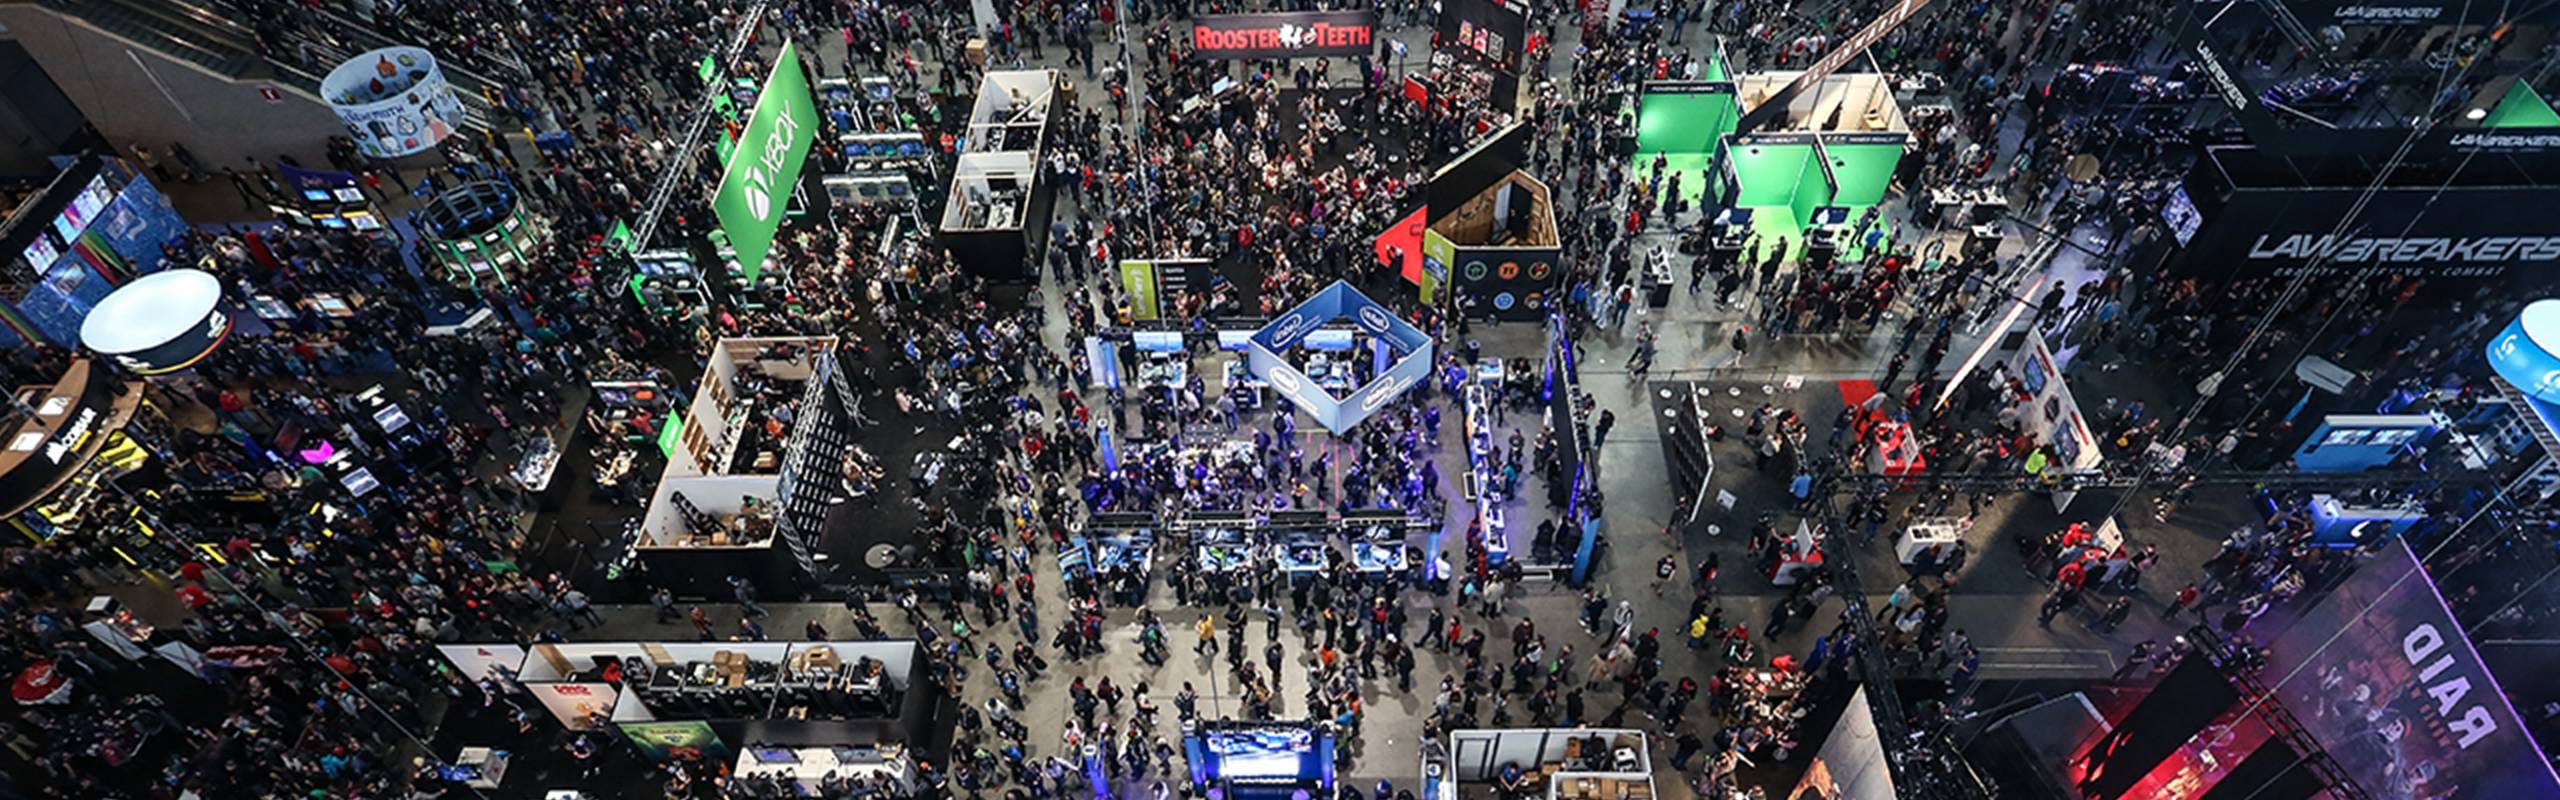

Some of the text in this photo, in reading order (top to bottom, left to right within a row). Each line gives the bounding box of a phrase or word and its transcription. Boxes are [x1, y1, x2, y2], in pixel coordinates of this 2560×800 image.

[1195, 22, 1371, 49] ROOSTER TEETH
[760, 100, 798, 187] XBOX
